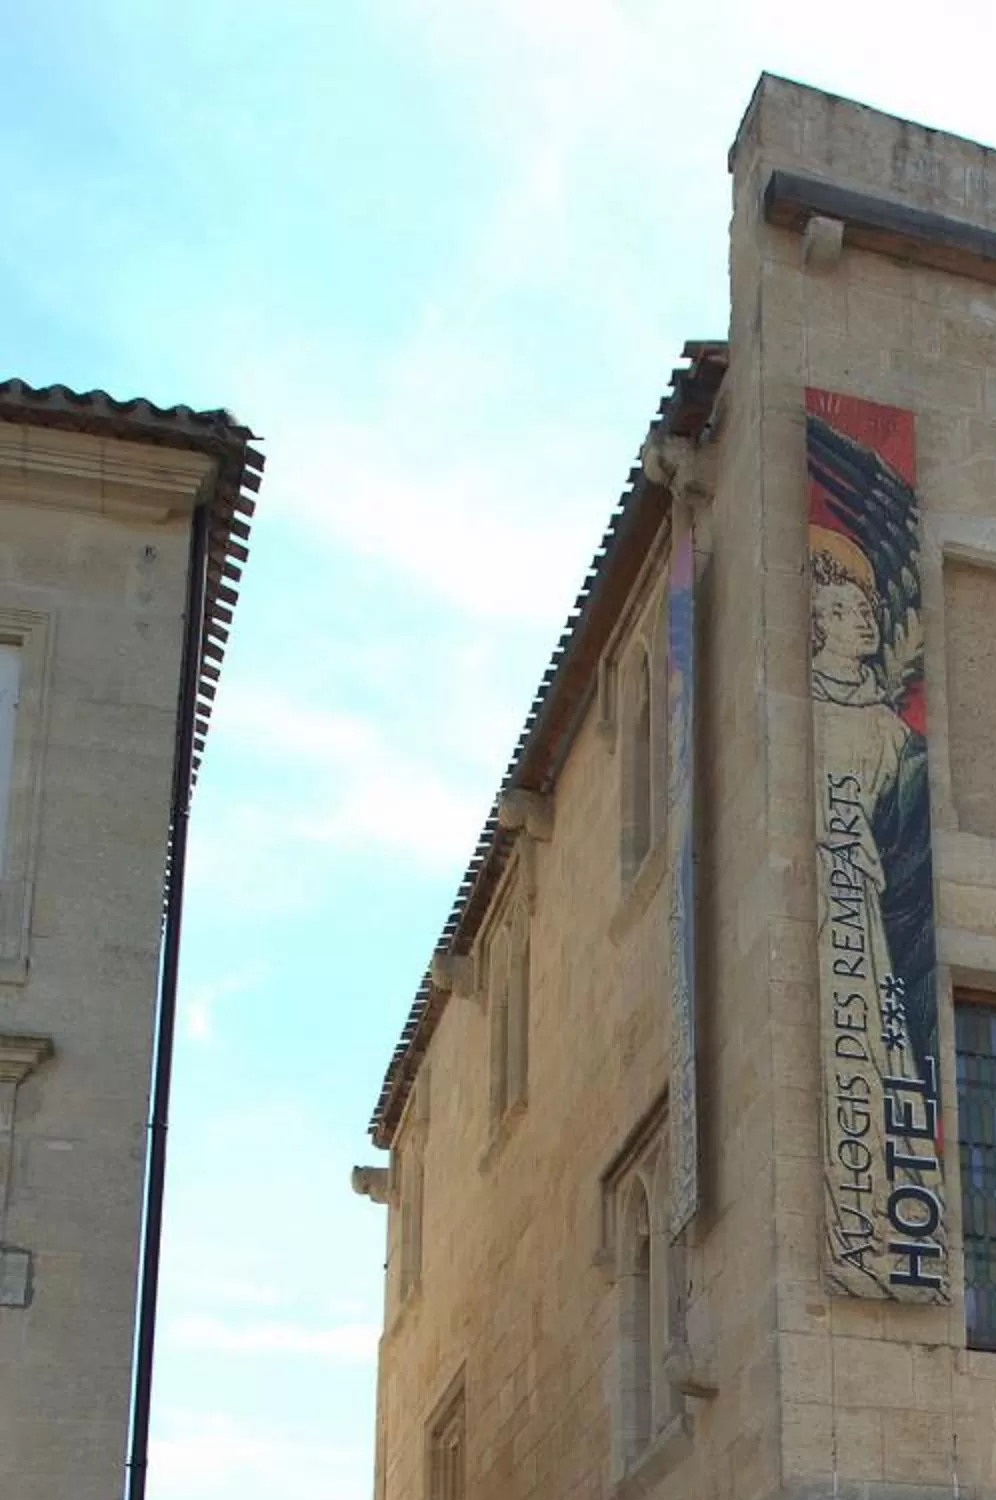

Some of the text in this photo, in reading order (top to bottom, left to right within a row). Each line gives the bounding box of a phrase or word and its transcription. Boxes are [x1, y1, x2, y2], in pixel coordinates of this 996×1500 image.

[827, 773, 879, 1281] AU LOGIS DES REMPARTS
[883, 1055, 943, 1288] HOTEL
